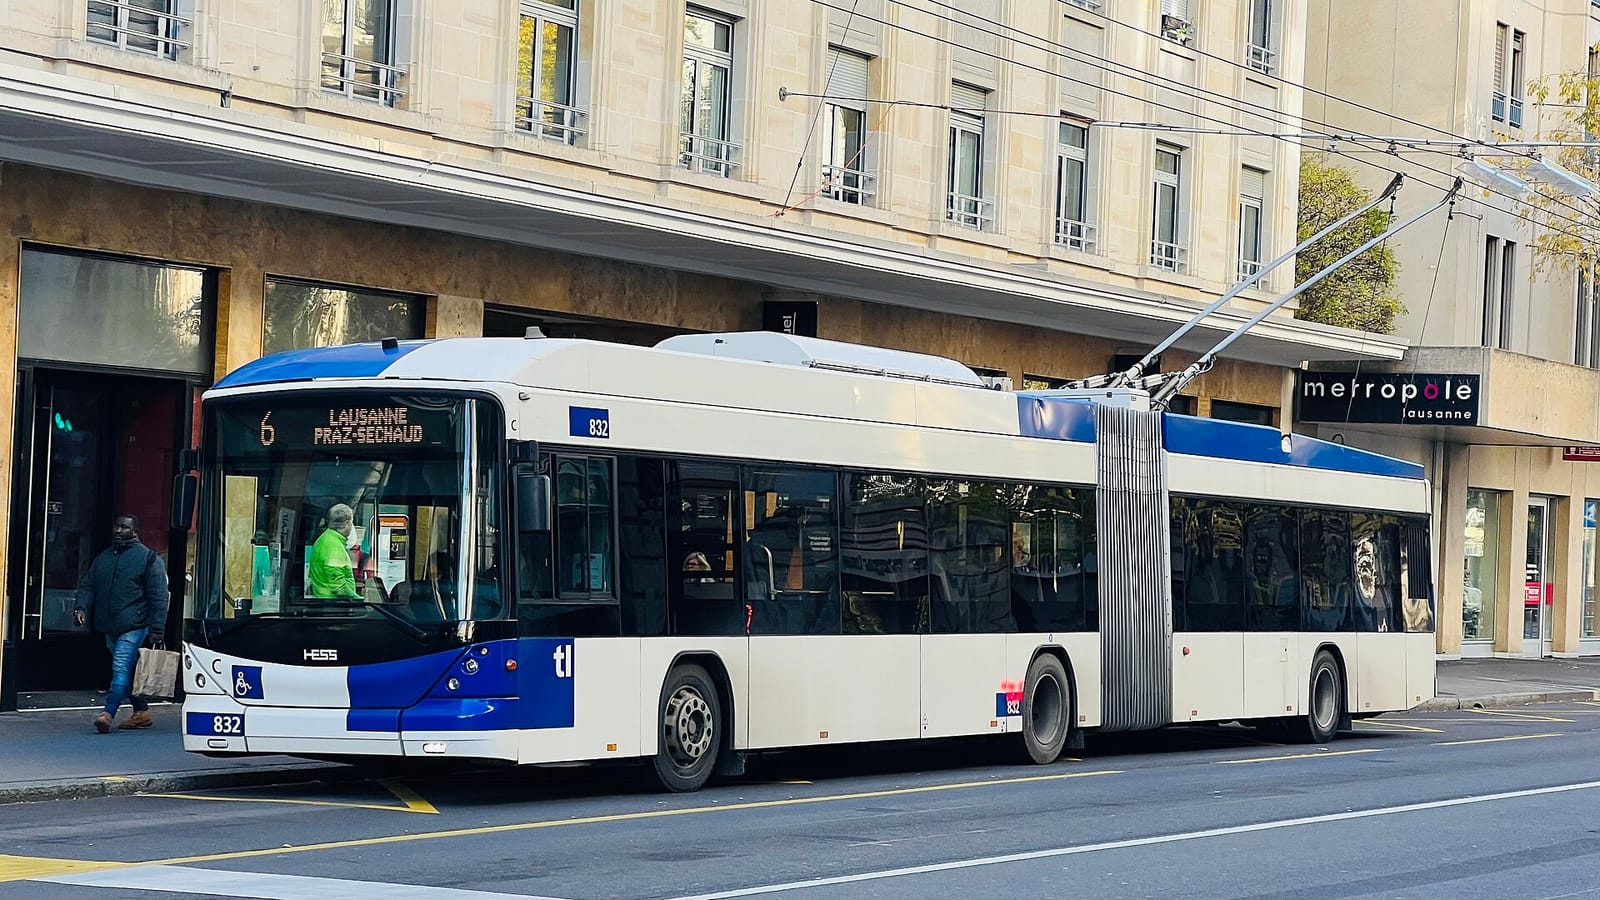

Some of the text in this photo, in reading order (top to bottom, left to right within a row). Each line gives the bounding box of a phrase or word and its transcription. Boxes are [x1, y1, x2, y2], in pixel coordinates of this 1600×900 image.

[329, 407, 408, 426] LAUSANNE
[1402, 407, 1472, 420] lausanne
[260, 411, 275, 446] 6
[314, 425, 423, 445] PRAZ-SECHAUD
[589, 418, 609, 437] 832
[303, 649, 338, 661] HESS
[553, 644, 572, 678] tl
[213, 715, 241, 734] 832
